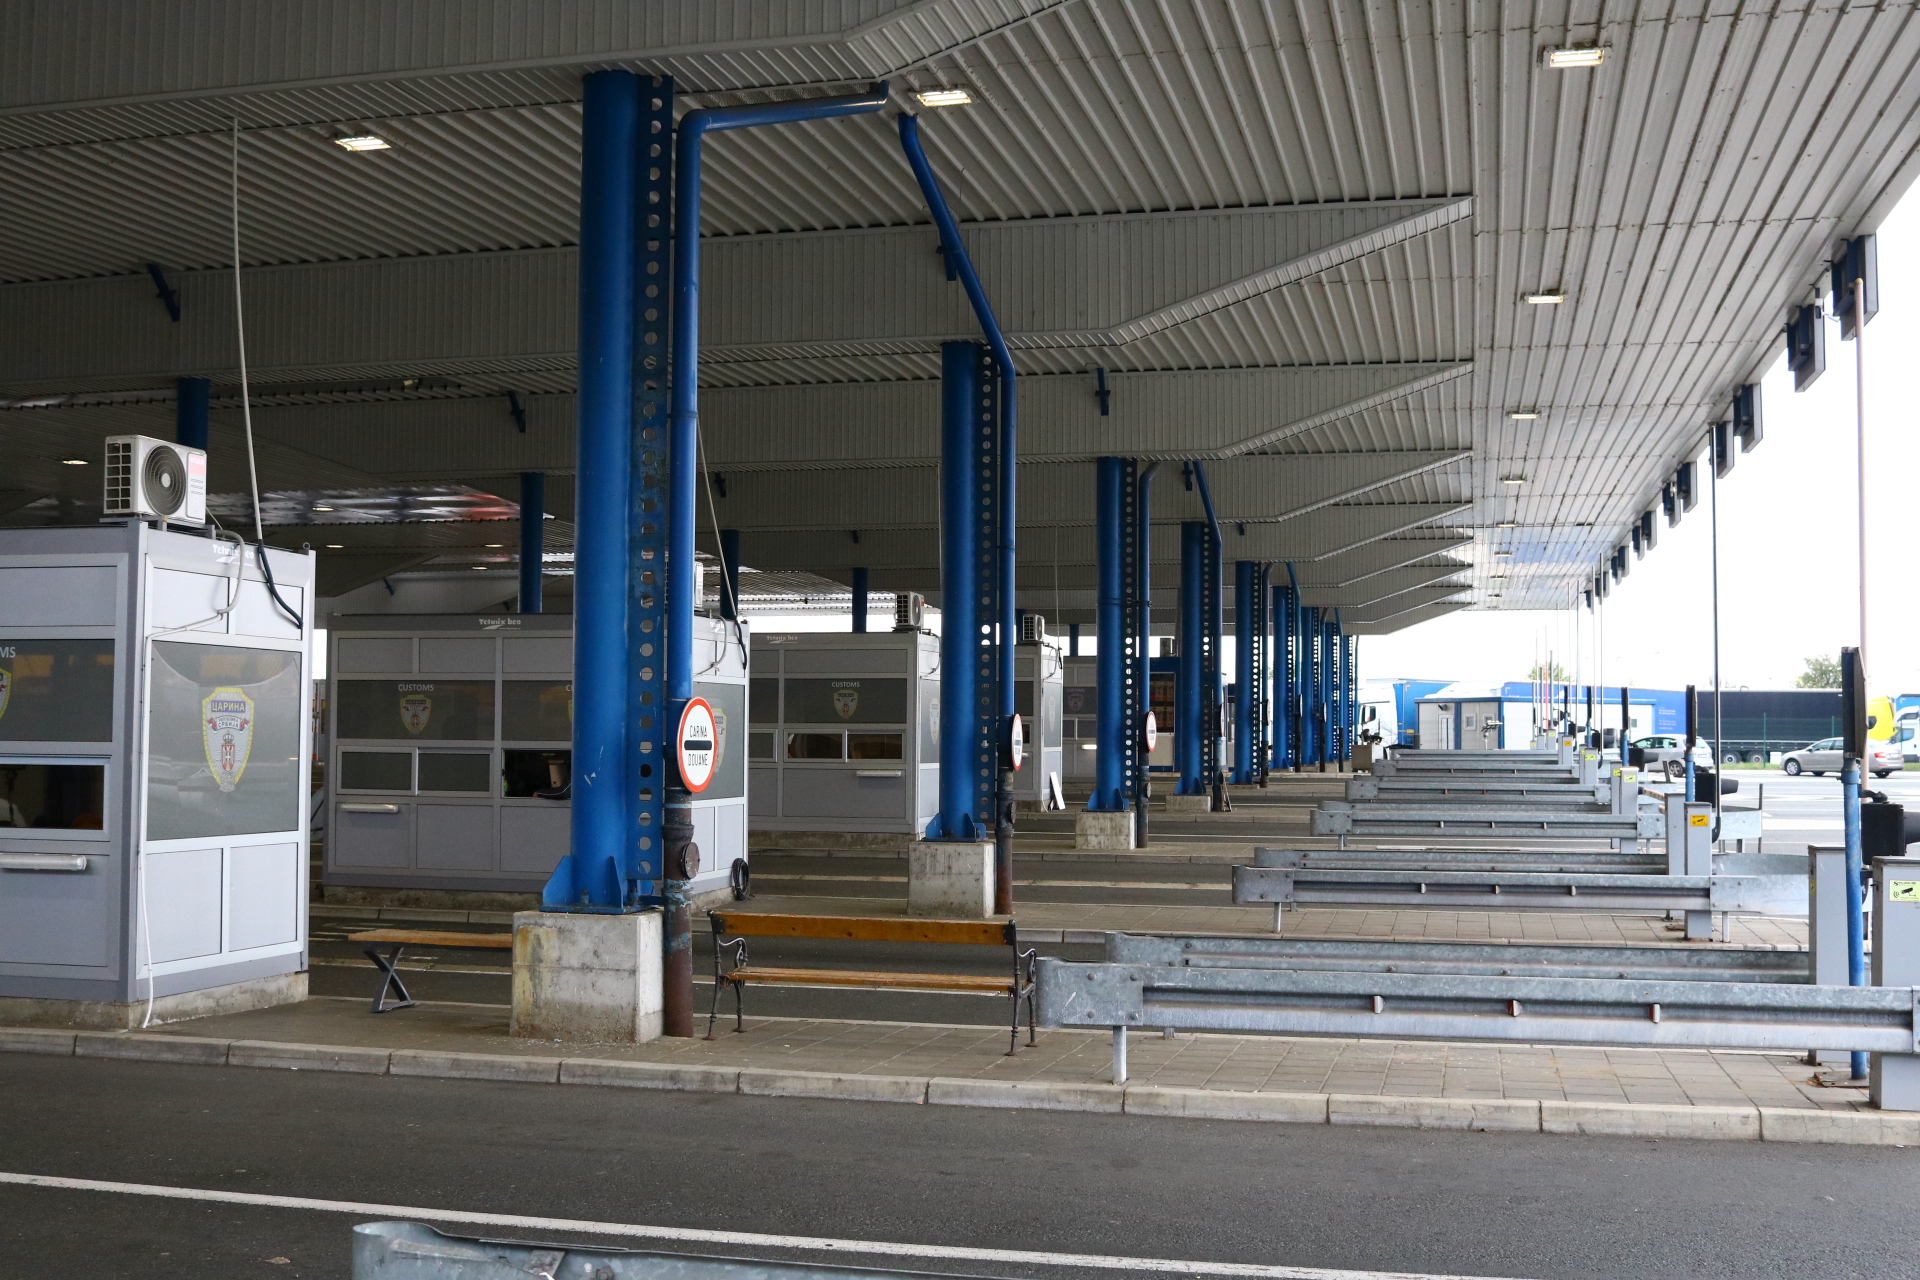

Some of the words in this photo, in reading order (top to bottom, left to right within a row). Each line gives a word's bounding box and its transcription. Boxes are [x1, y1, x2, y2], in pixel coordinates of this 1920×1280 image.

[398, 683, 435, 692] CUSTOMS
[212, 701, 246, 712] ЦАРИНА
[689, 725, 708, 738] CARINA
[688, 753, 709, 766] DOUANE
